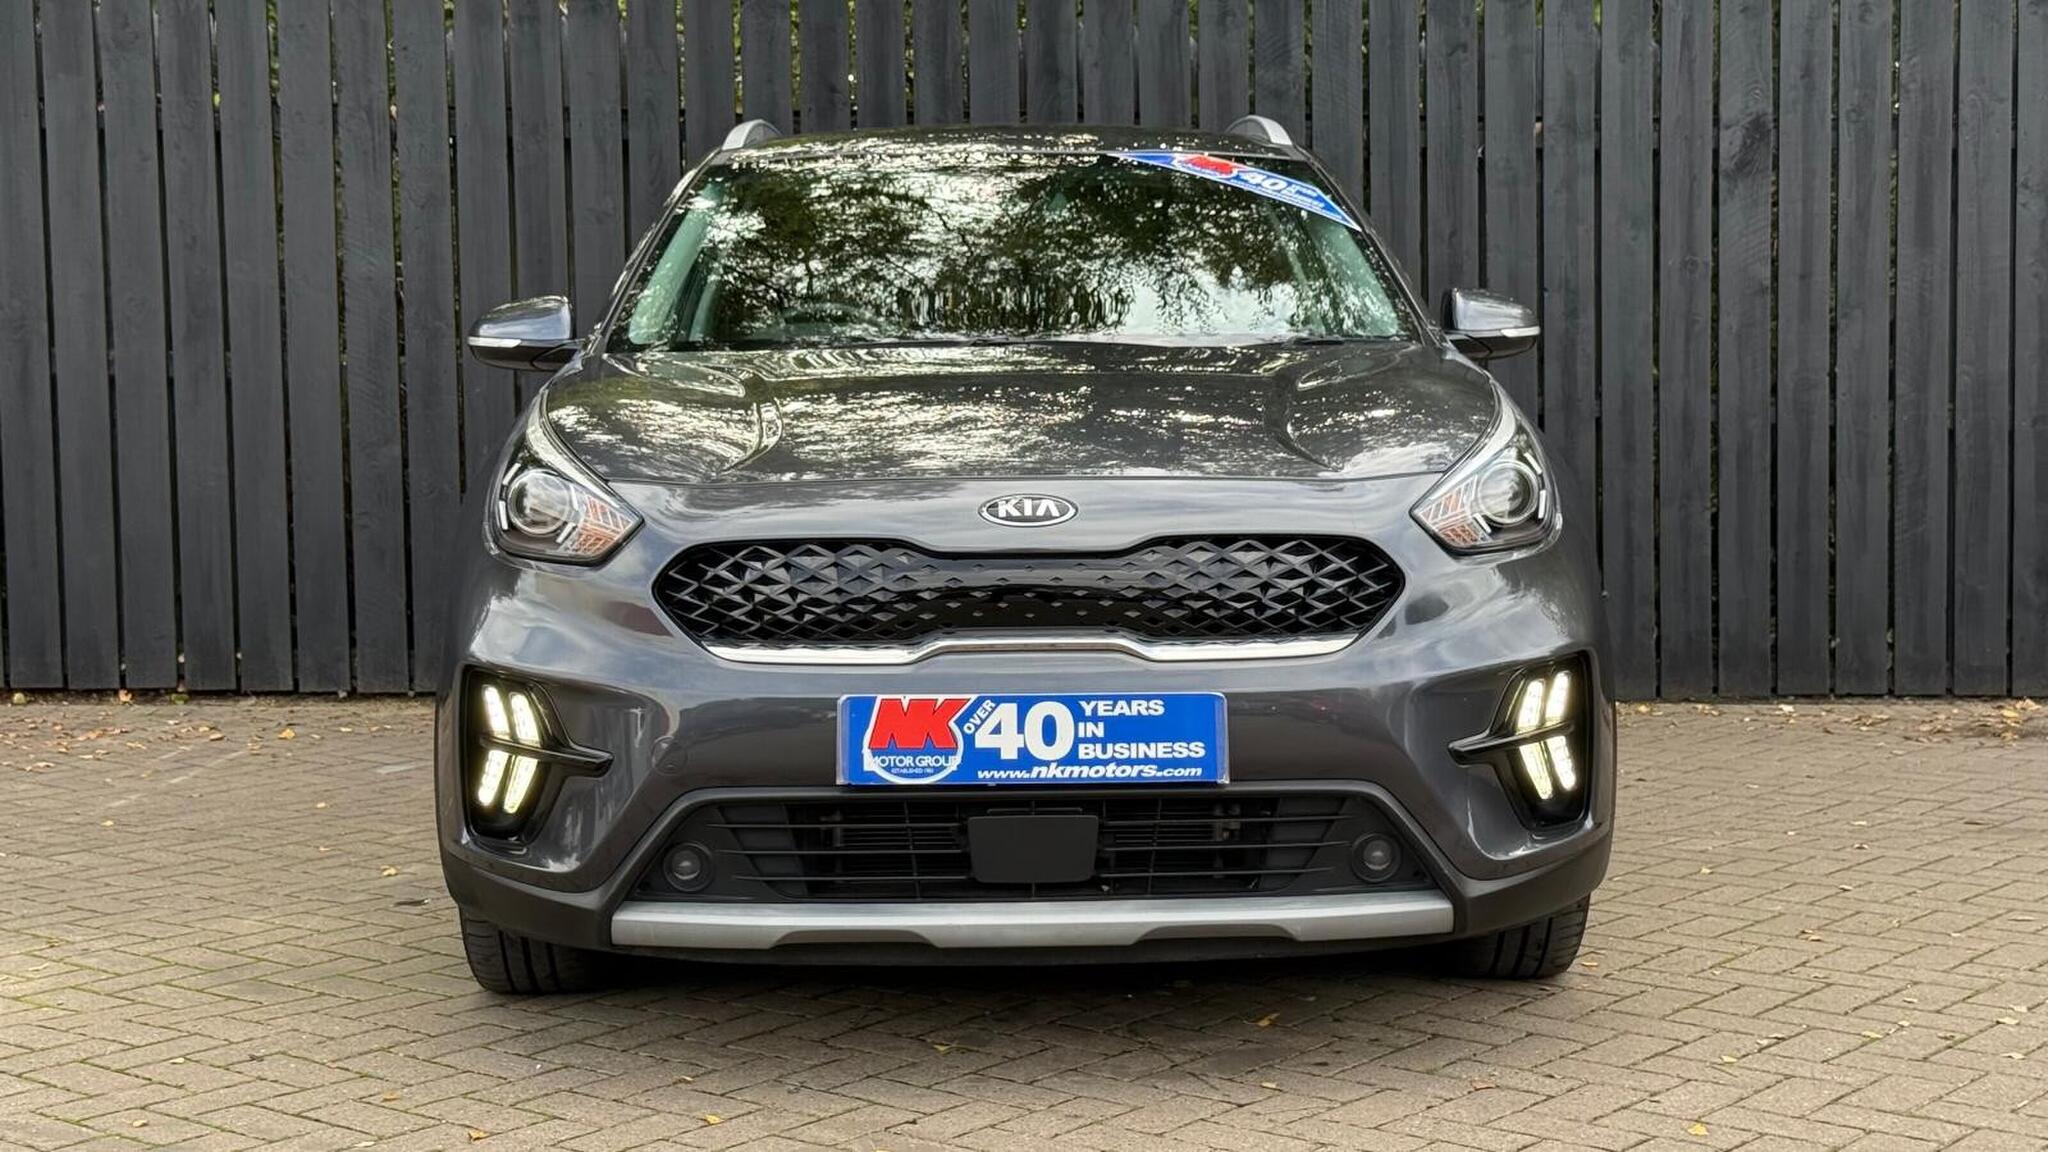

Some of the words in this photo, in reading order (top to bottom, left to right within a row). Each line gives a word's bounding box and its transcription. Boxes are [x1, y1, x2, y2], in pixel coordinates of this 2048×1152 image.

[1238, 171, 1289, 190] 40
[998, 498, 1060, 517] KIA
[963, 699, 996, 734] OVER
[1078, 700, 1165, 716] YEARS
[868, 698, 971, 750] NK
[975, 701, 1075, 761] 40
[1078, 721, 1105, 738] IN
[1078, 742, 1206, 759] BUSINESS
[977, 762, 1203, 779] www.nkmotors.com
